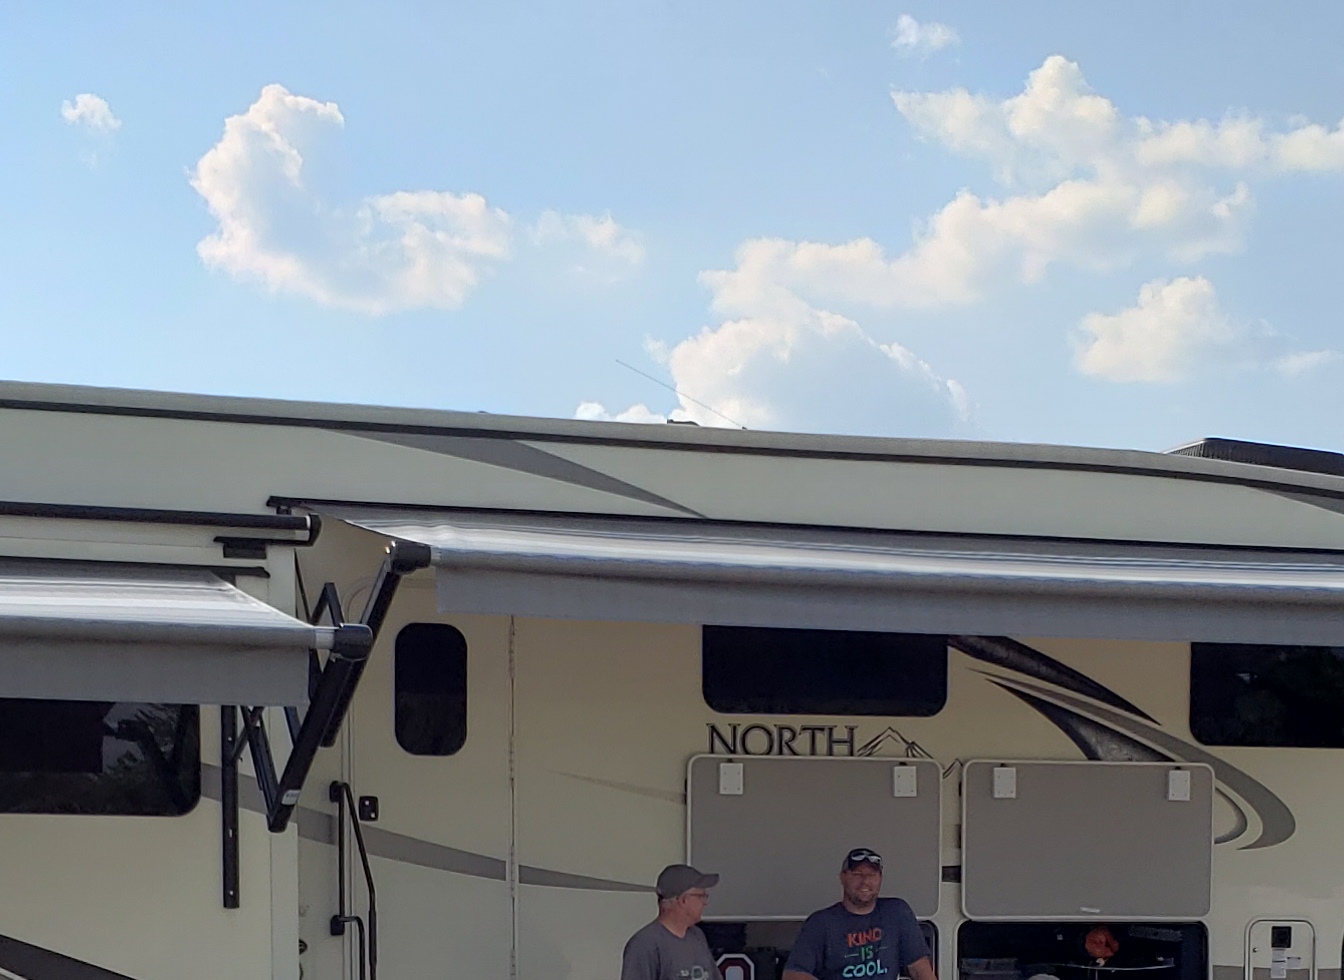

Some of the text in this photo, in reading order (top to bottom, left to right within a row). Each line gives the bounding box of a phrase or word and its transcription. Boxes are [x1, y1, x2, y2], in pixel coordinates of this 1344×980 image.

[706, 723, 859, 756] NORTH
[861, 945, 874, 961] IS
[842, 959, 888, 978] COOL.
